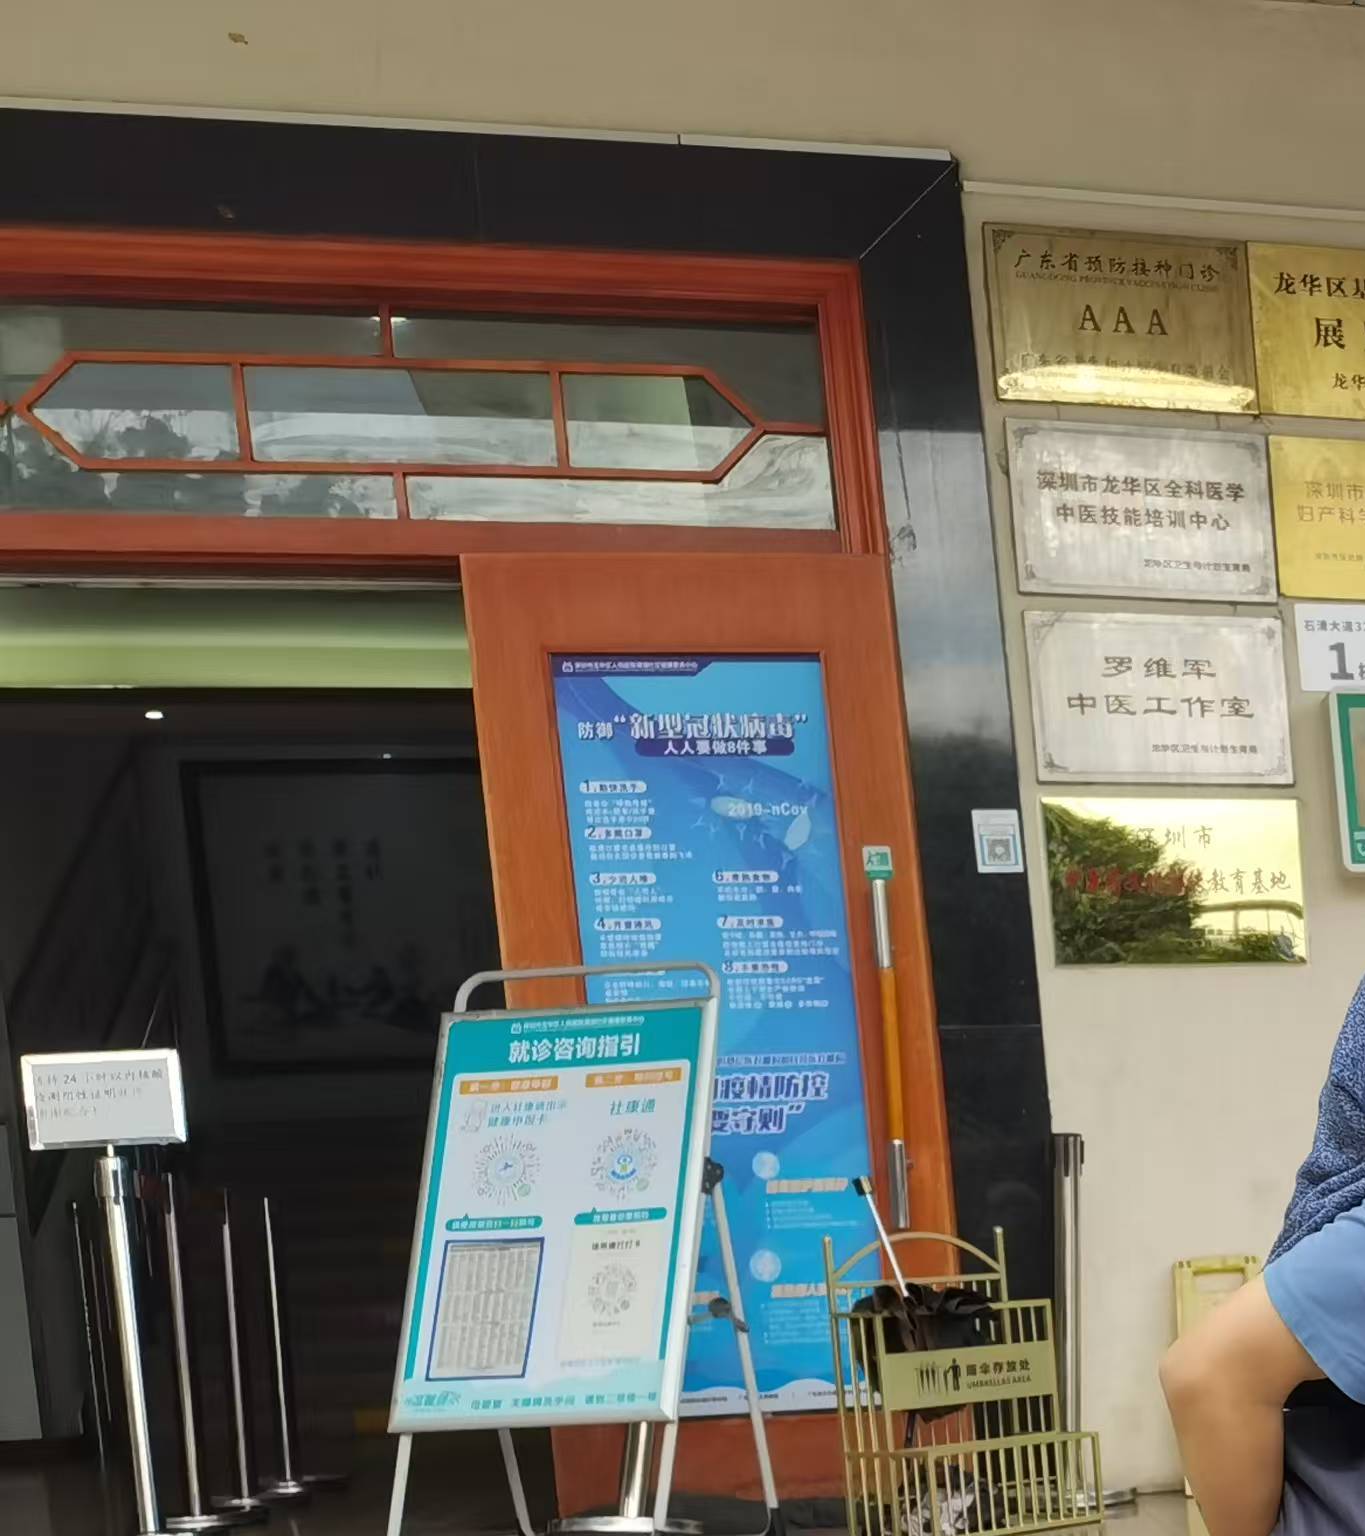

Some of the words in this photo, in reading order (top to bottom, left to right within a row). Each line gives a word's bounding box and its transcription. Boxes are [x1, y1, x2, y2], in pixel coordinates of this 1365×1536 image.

[1014, 249, 1220, 282] 广东省预防接种门诊
[1035, 470, 1245, 502] 深圳市龙华区全科医学
[1056, 503, 1231, 532] 中医技能培训中心
[1101, 655, 1217, 680] 罗维军
[1066, 692, 1255, 719] 中医工作室
[664, 739, 768, 755] 人人要做8件事
[1135, 824, 1214, 850] 深圳市
[508, 1032, 641, 1065] 就诊咨询指引
[609, 1098, 656, 1116] 社康通
